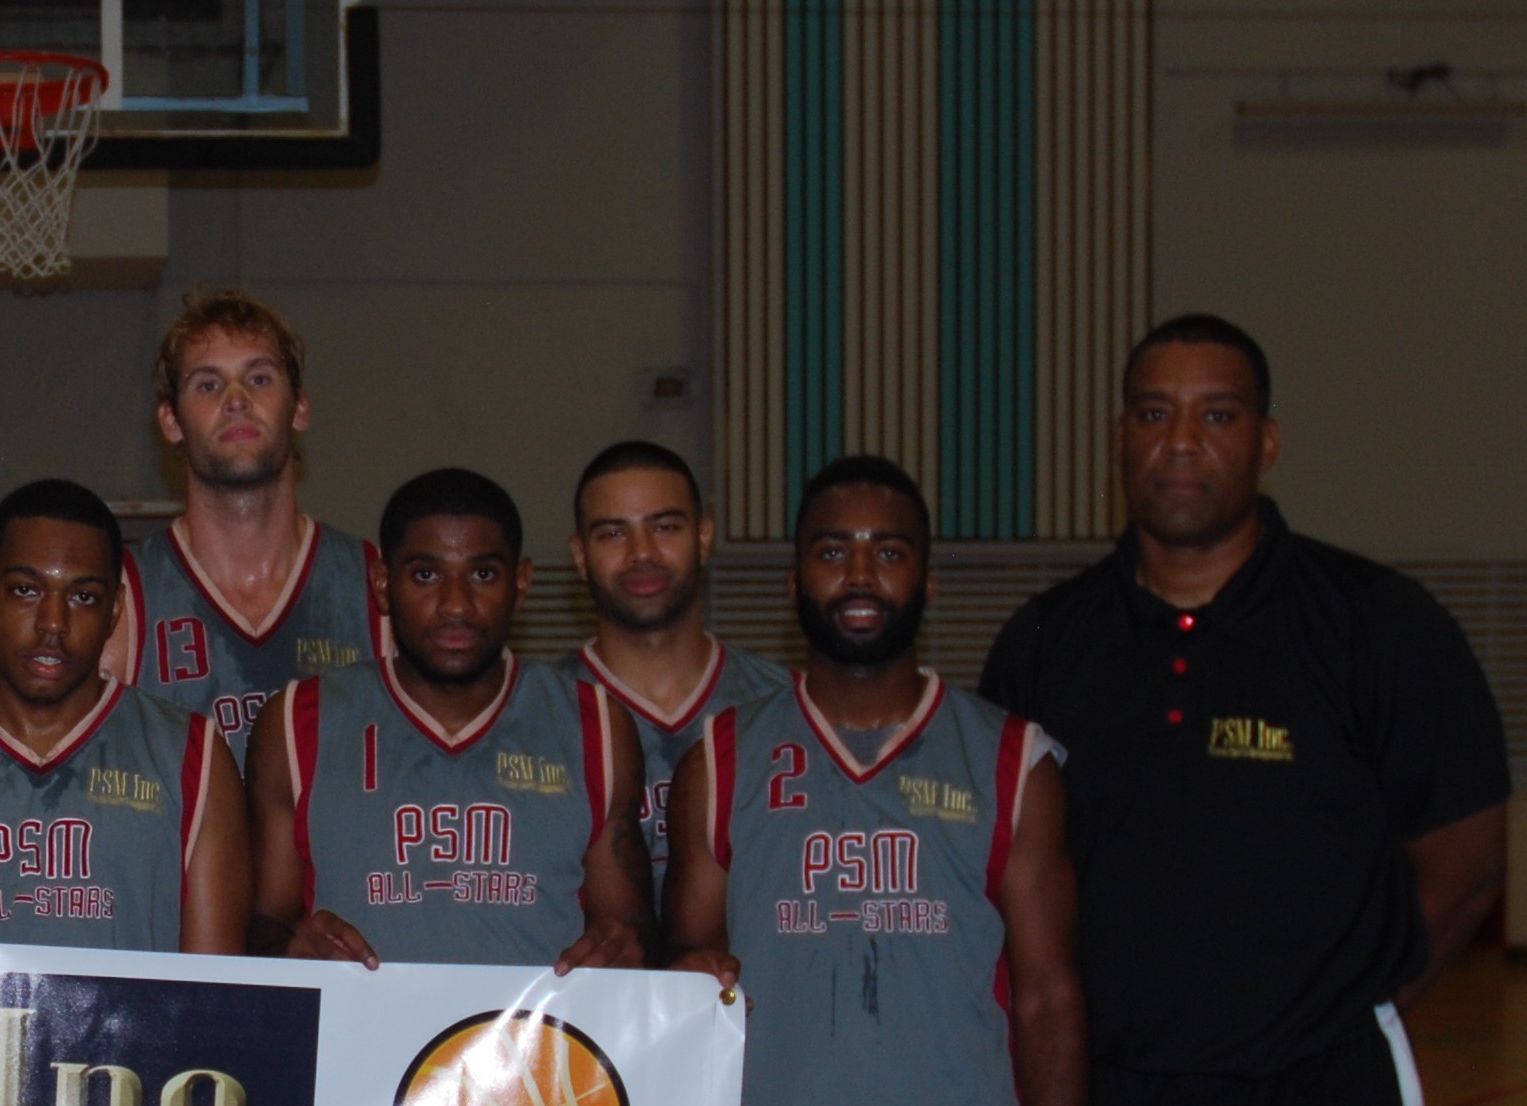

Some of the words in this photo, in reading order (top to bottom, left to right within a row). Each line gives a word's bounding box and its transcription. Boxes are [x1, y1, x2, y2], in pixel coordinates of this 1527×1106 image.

[156, 617, 209, 684] 13
[89, 767, 129, 796] PSM
[362, 723, 378, 792] 1
[497, 752, 534, 780] PSM
[768, 743, 807, 812] 2
[394, 804, 511, 865] PSM
[803, 829, 920, 894] PSM
[368, 871, 537, 905] ALL-STARS
[777, 899, 951, 934] ALL-STARS
